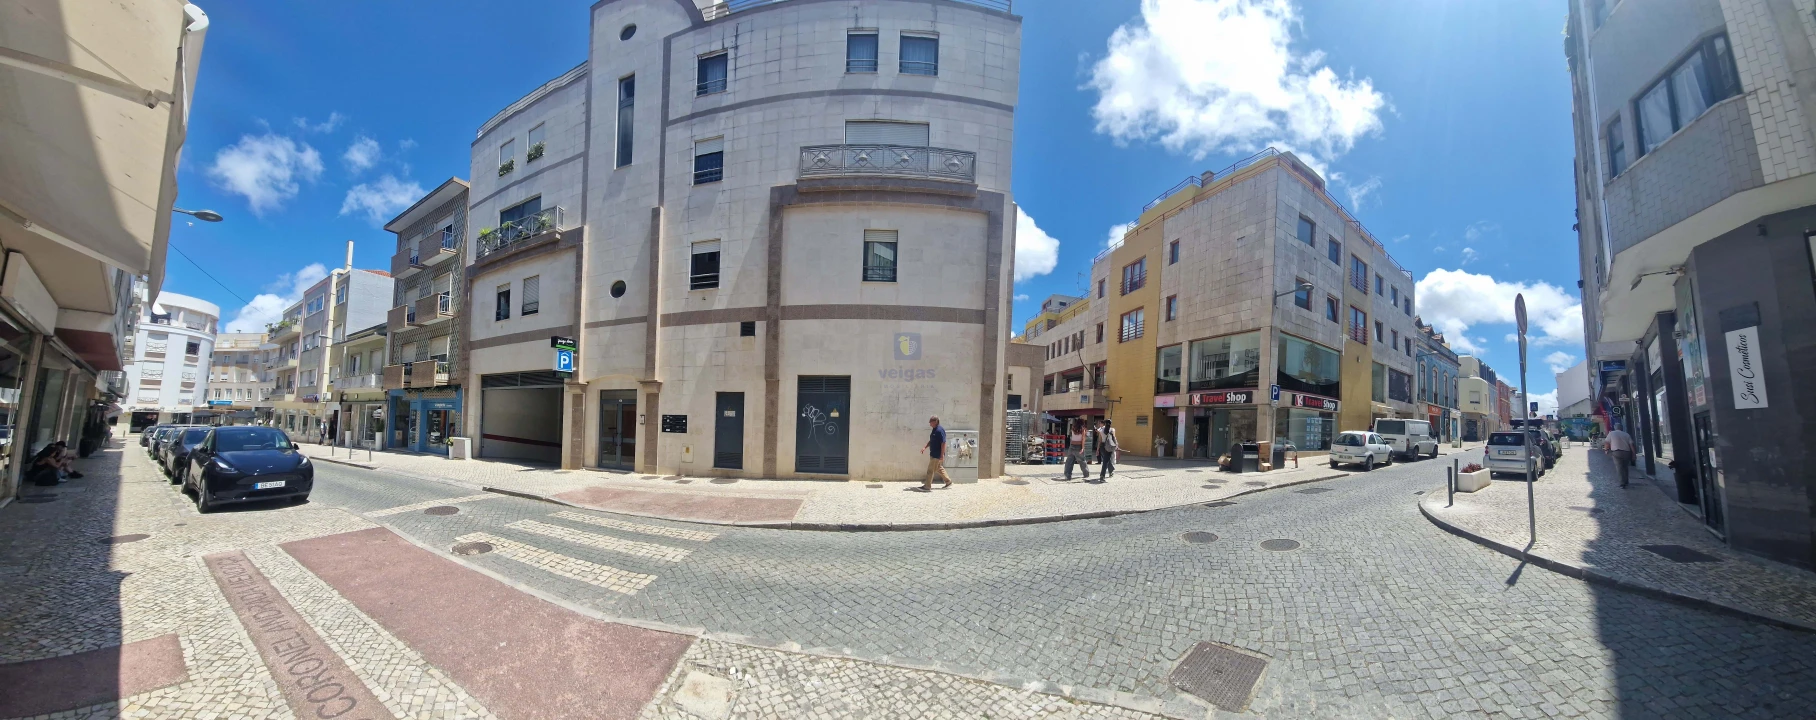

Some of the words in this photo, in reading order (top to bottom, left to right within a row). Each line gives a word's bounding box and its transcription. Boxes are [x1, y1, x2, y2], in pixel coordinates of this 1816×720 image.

[561, 356, 569, 368] P
[1203, 392, 1225, 402] Travel
[1226, 391, 1247, 404] Shop
[1272, 386, 1279, 399] P
[1740, 380, 1760, 404] Susi
[1305, 396, 1323, 407] Travel
[1323, 399, 1336, 411] Shop
[270, 631, 358, 720] CORONEL
